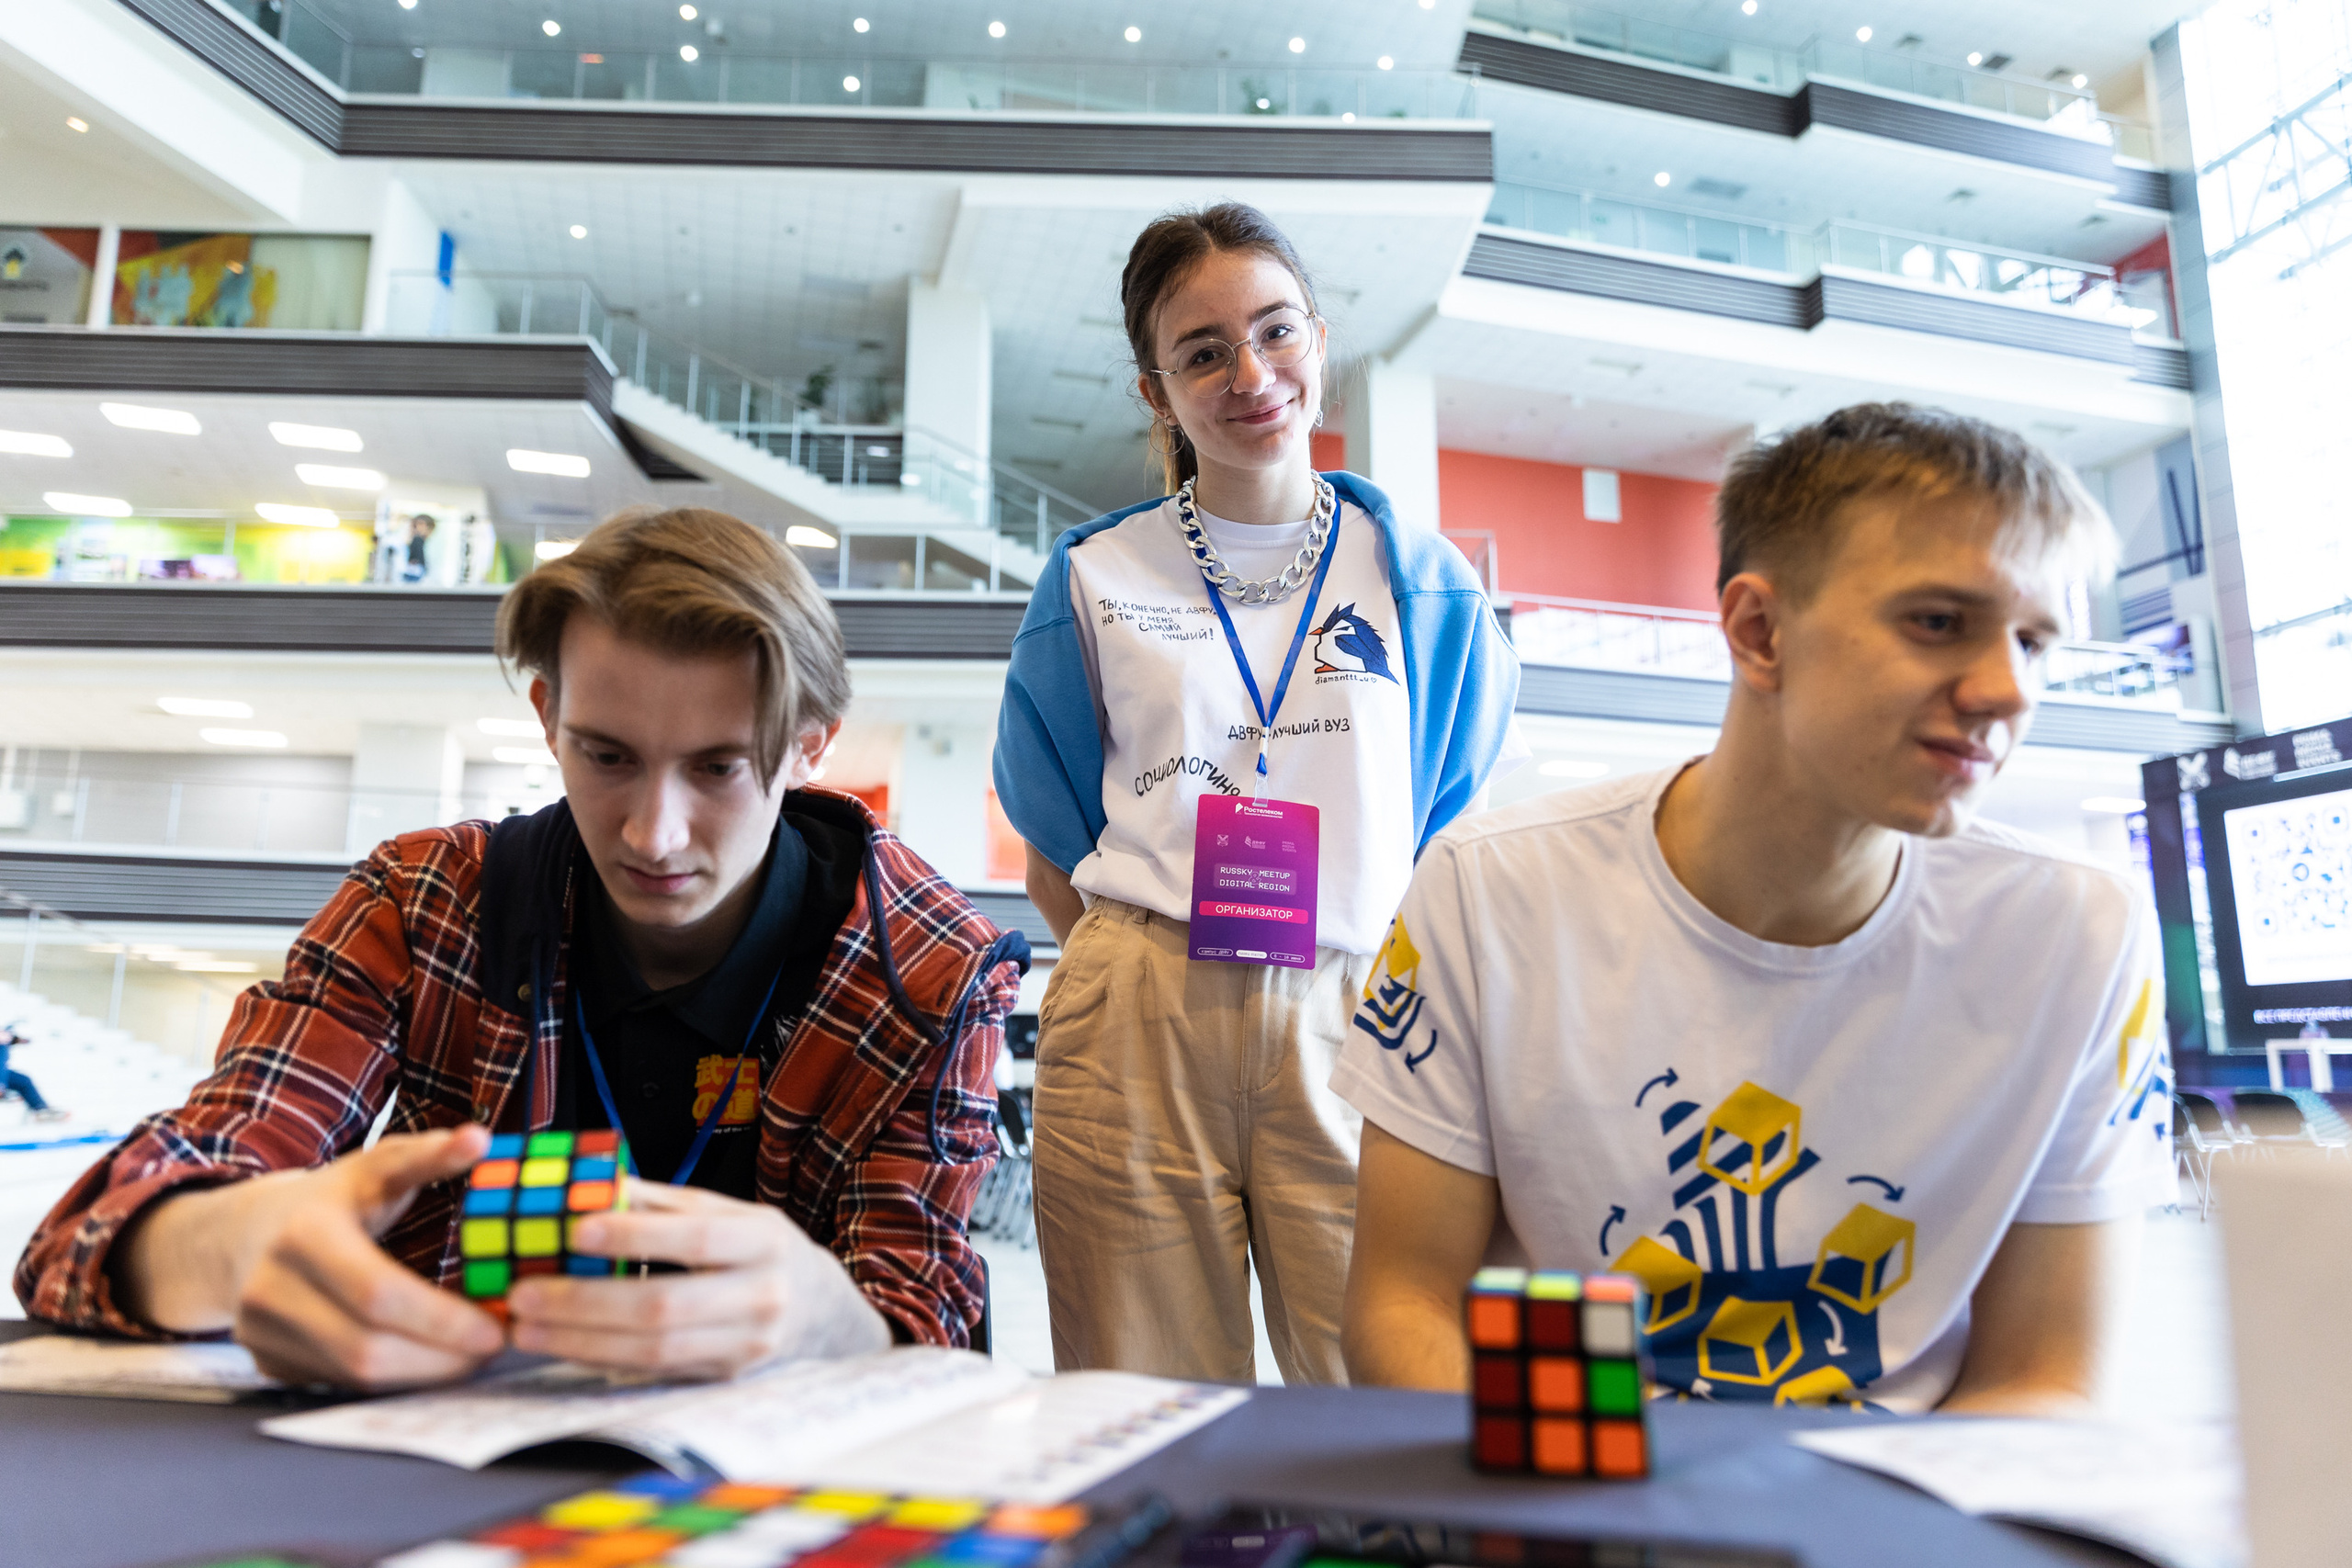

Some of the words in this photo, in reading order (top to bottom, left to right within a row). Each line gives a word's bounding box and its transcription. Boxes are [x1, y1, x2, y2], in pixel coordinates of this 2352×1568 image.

[1098, 599, 1121, 612] ТЫ,
[1102, 614, 1114, 627] НО
[1117, 613, 1135, 621] ТЫ
[1147, 615, 1174, 624] МЕНЯ
[1138, 622, 1182, 632] САМЫЙ
[1161, 627, 1214, 641] ЛУЧШИЙ!
[1272, 718, 1319, 739] ЛУЧШИЙ
[1324, 717, 1351, 732] ВУЗ
[1243, 806, 1283, 816] Ростелеком
[1220, 866, 1252, 875] RUSSKY
[1259, 870, 1291, 879] MEETUP
[1219, 879, 1255, 888] DIGITAL
[1259, 882, 1290, 892] REGION
[1216, 904, 1293, 919] ОРГАНИЗАТОР
